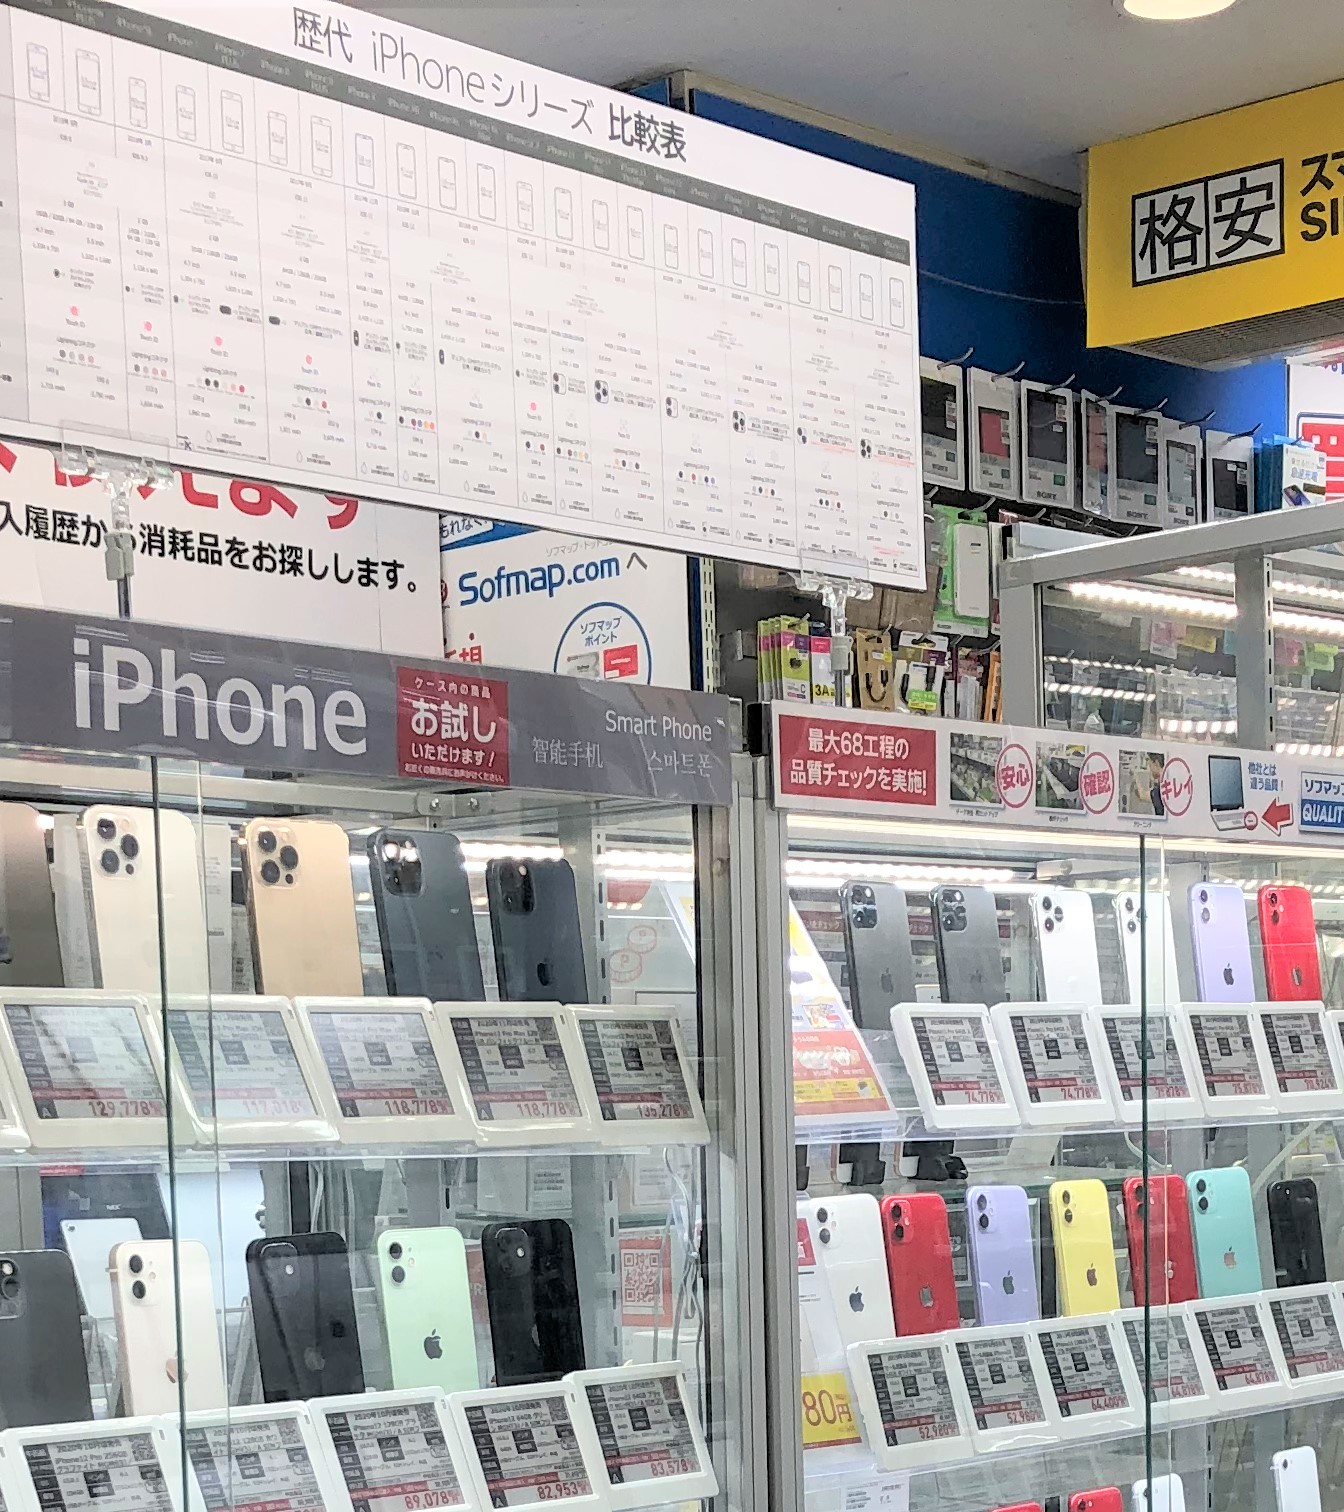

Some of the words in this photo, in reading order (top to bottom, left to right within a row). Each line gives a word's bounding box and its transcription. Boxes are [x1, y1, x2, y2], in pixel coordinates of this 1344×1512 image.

[291, 6, 353, 64] 歴代
[371, 30, 595, 132] iPhoneシリーズ
[607, 101, 688, 164] 比較表
[1137, 176, 1278, 276] 格安
[1126, 510, 1149, 521] SONY
[458, 556, 621, 607] Sofmap.com
[580, 616, 622, 634] ソフマップ
[584, 632, 619, 647] ポイント
[72, 638, 368, 757] iPhone
[814, 683, 830, 698] 3A
[411, 699, 497, 744] お試し
[605, 710, 657, 736] Smart
[662, 715, 713, 742] Phone
[532, 736, 604, 769] 智能手机
[806, 726, 911, 762] 最大68工程の
[1000, 763, 1031, 791] 安心
[1083, 769, 1111, 797] 確認
[1161, 773, 1193, 801] キレイ
